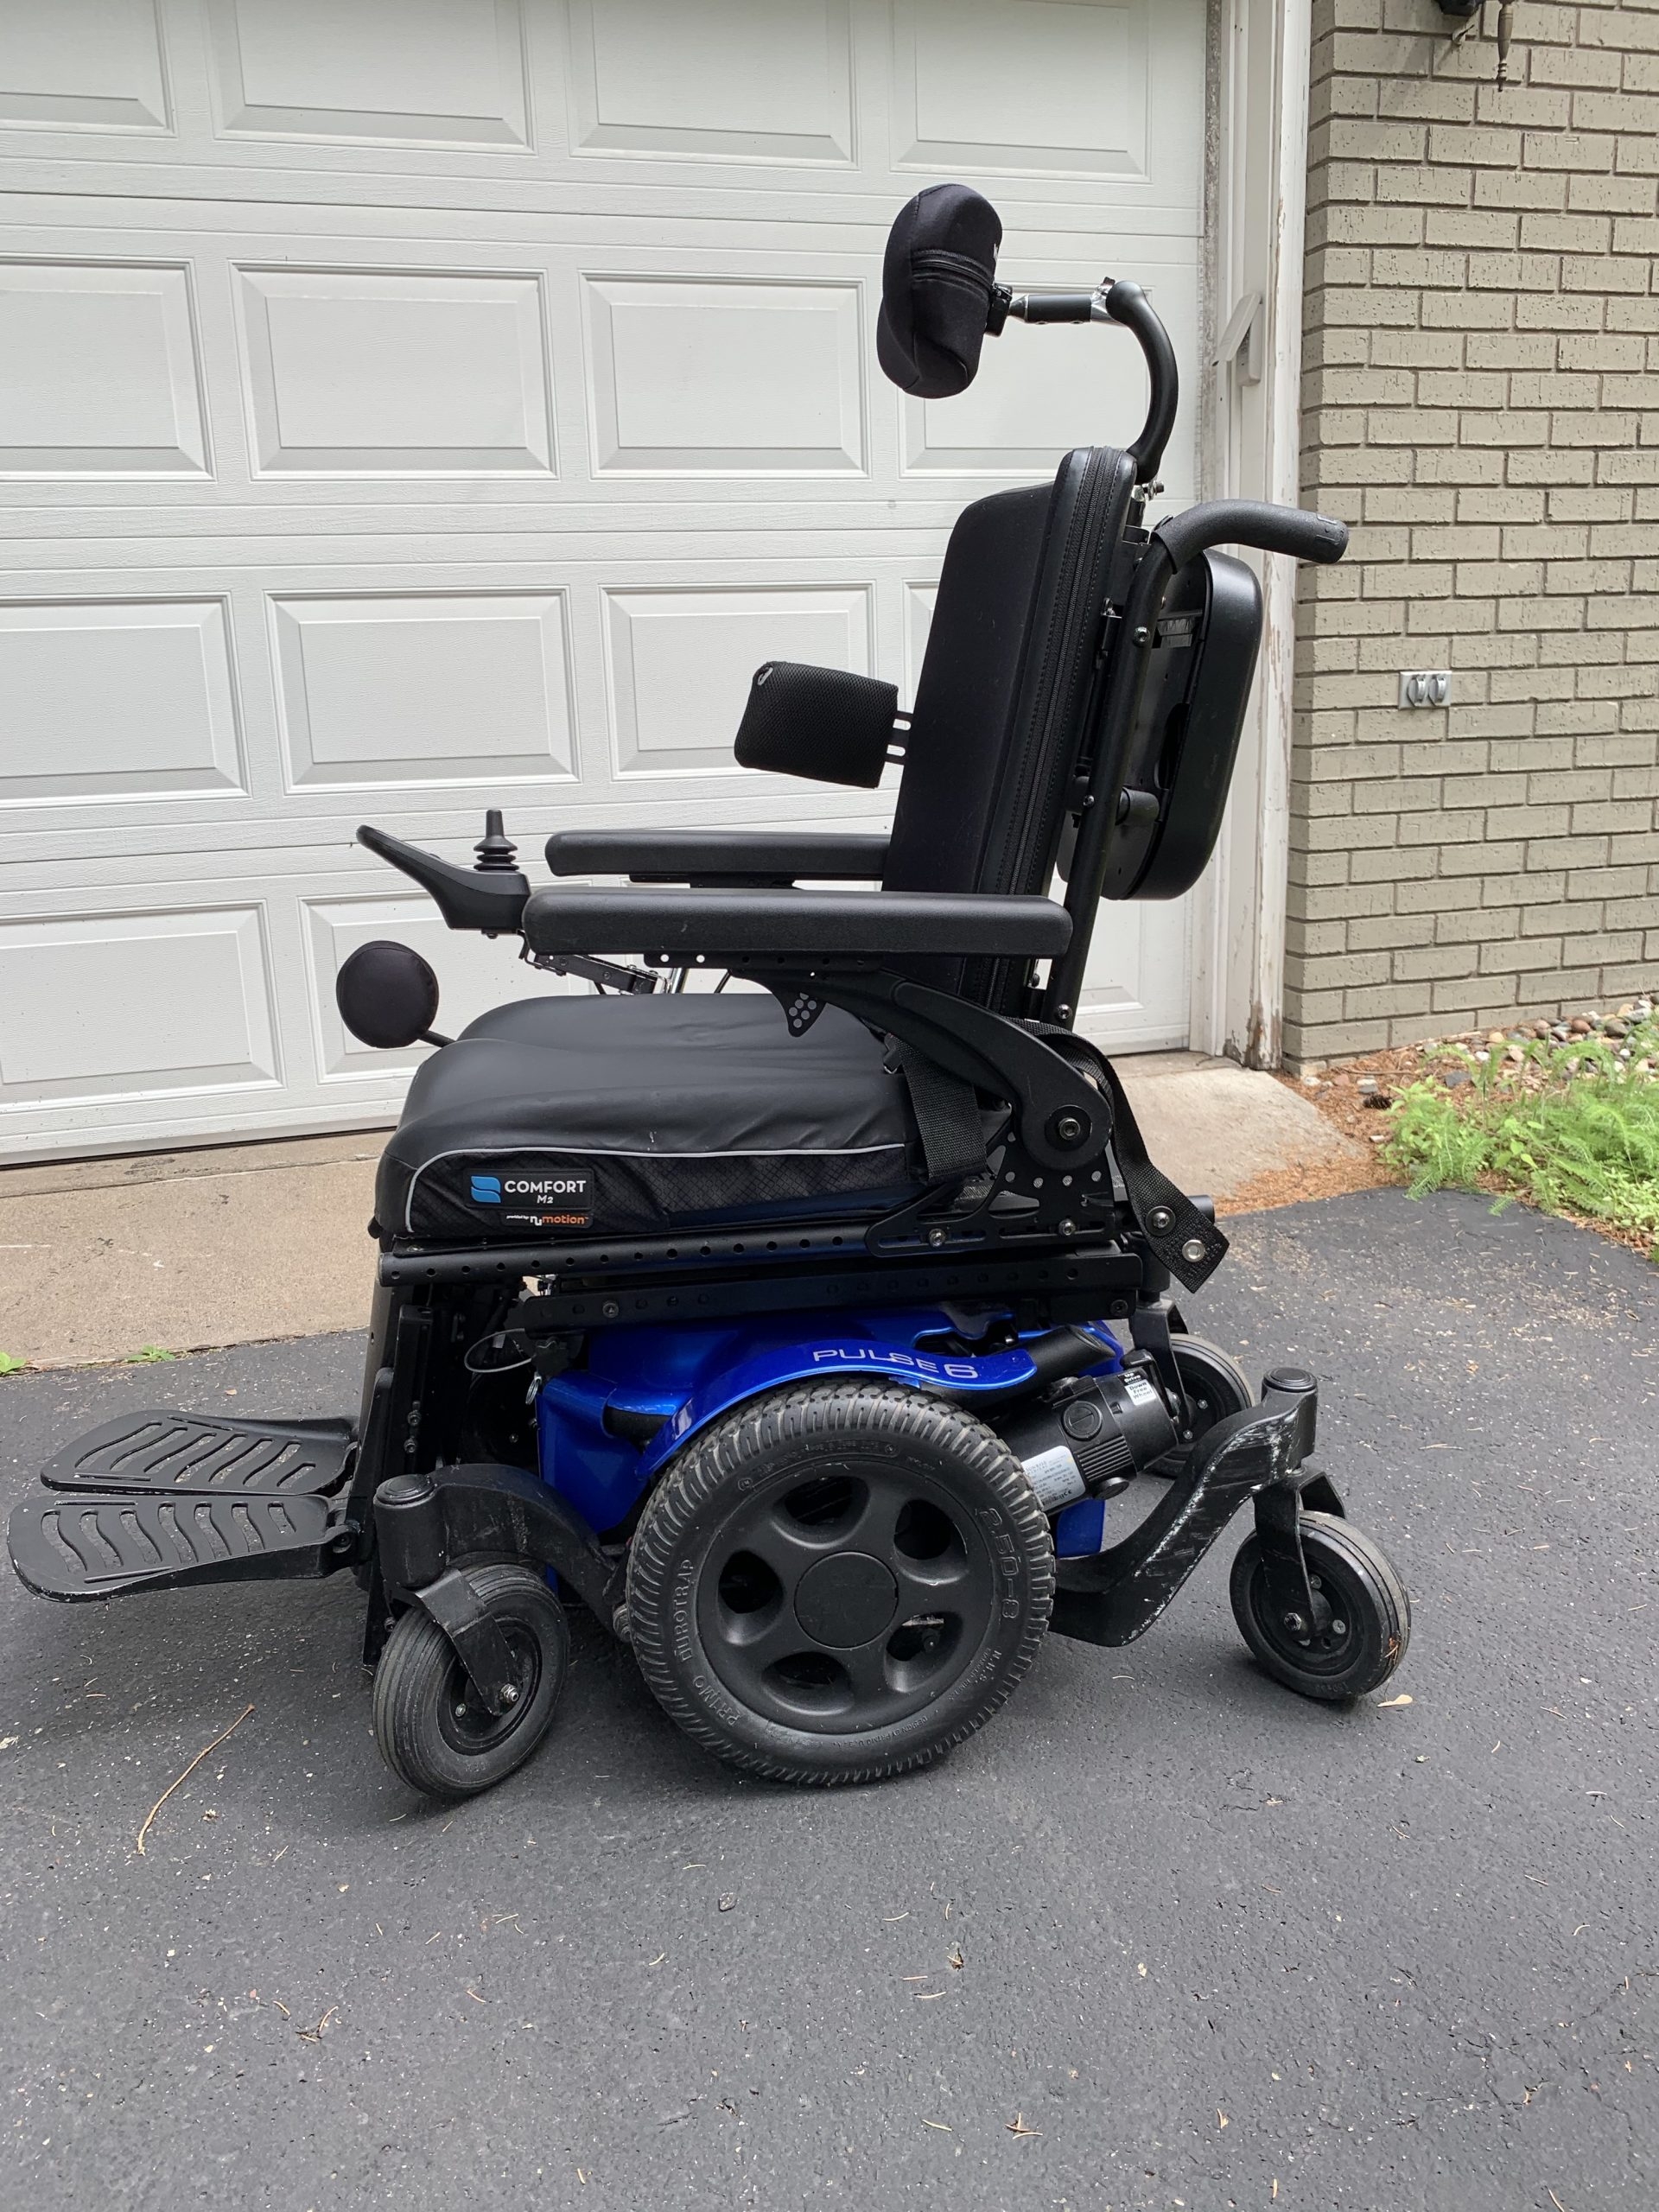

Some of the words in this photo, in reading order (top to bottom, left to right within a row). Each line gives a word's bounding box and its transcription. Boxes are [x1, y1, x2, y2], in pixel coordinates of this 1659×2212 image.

[504, 1180, 587, 1193] COMFORT
[537, 1195, 554, 1204] M2
[812, 1349, 940, 1373] PULSE
[944, 1363, 979, 1379] 6
[1129, 1382, 1147, 1390] Down
[1133, 1389, 1153, 1399] Wheel
[978, 1508, 1019, 1618] 2.50-8
[693, 1675, 741, 1726] PRIMO
